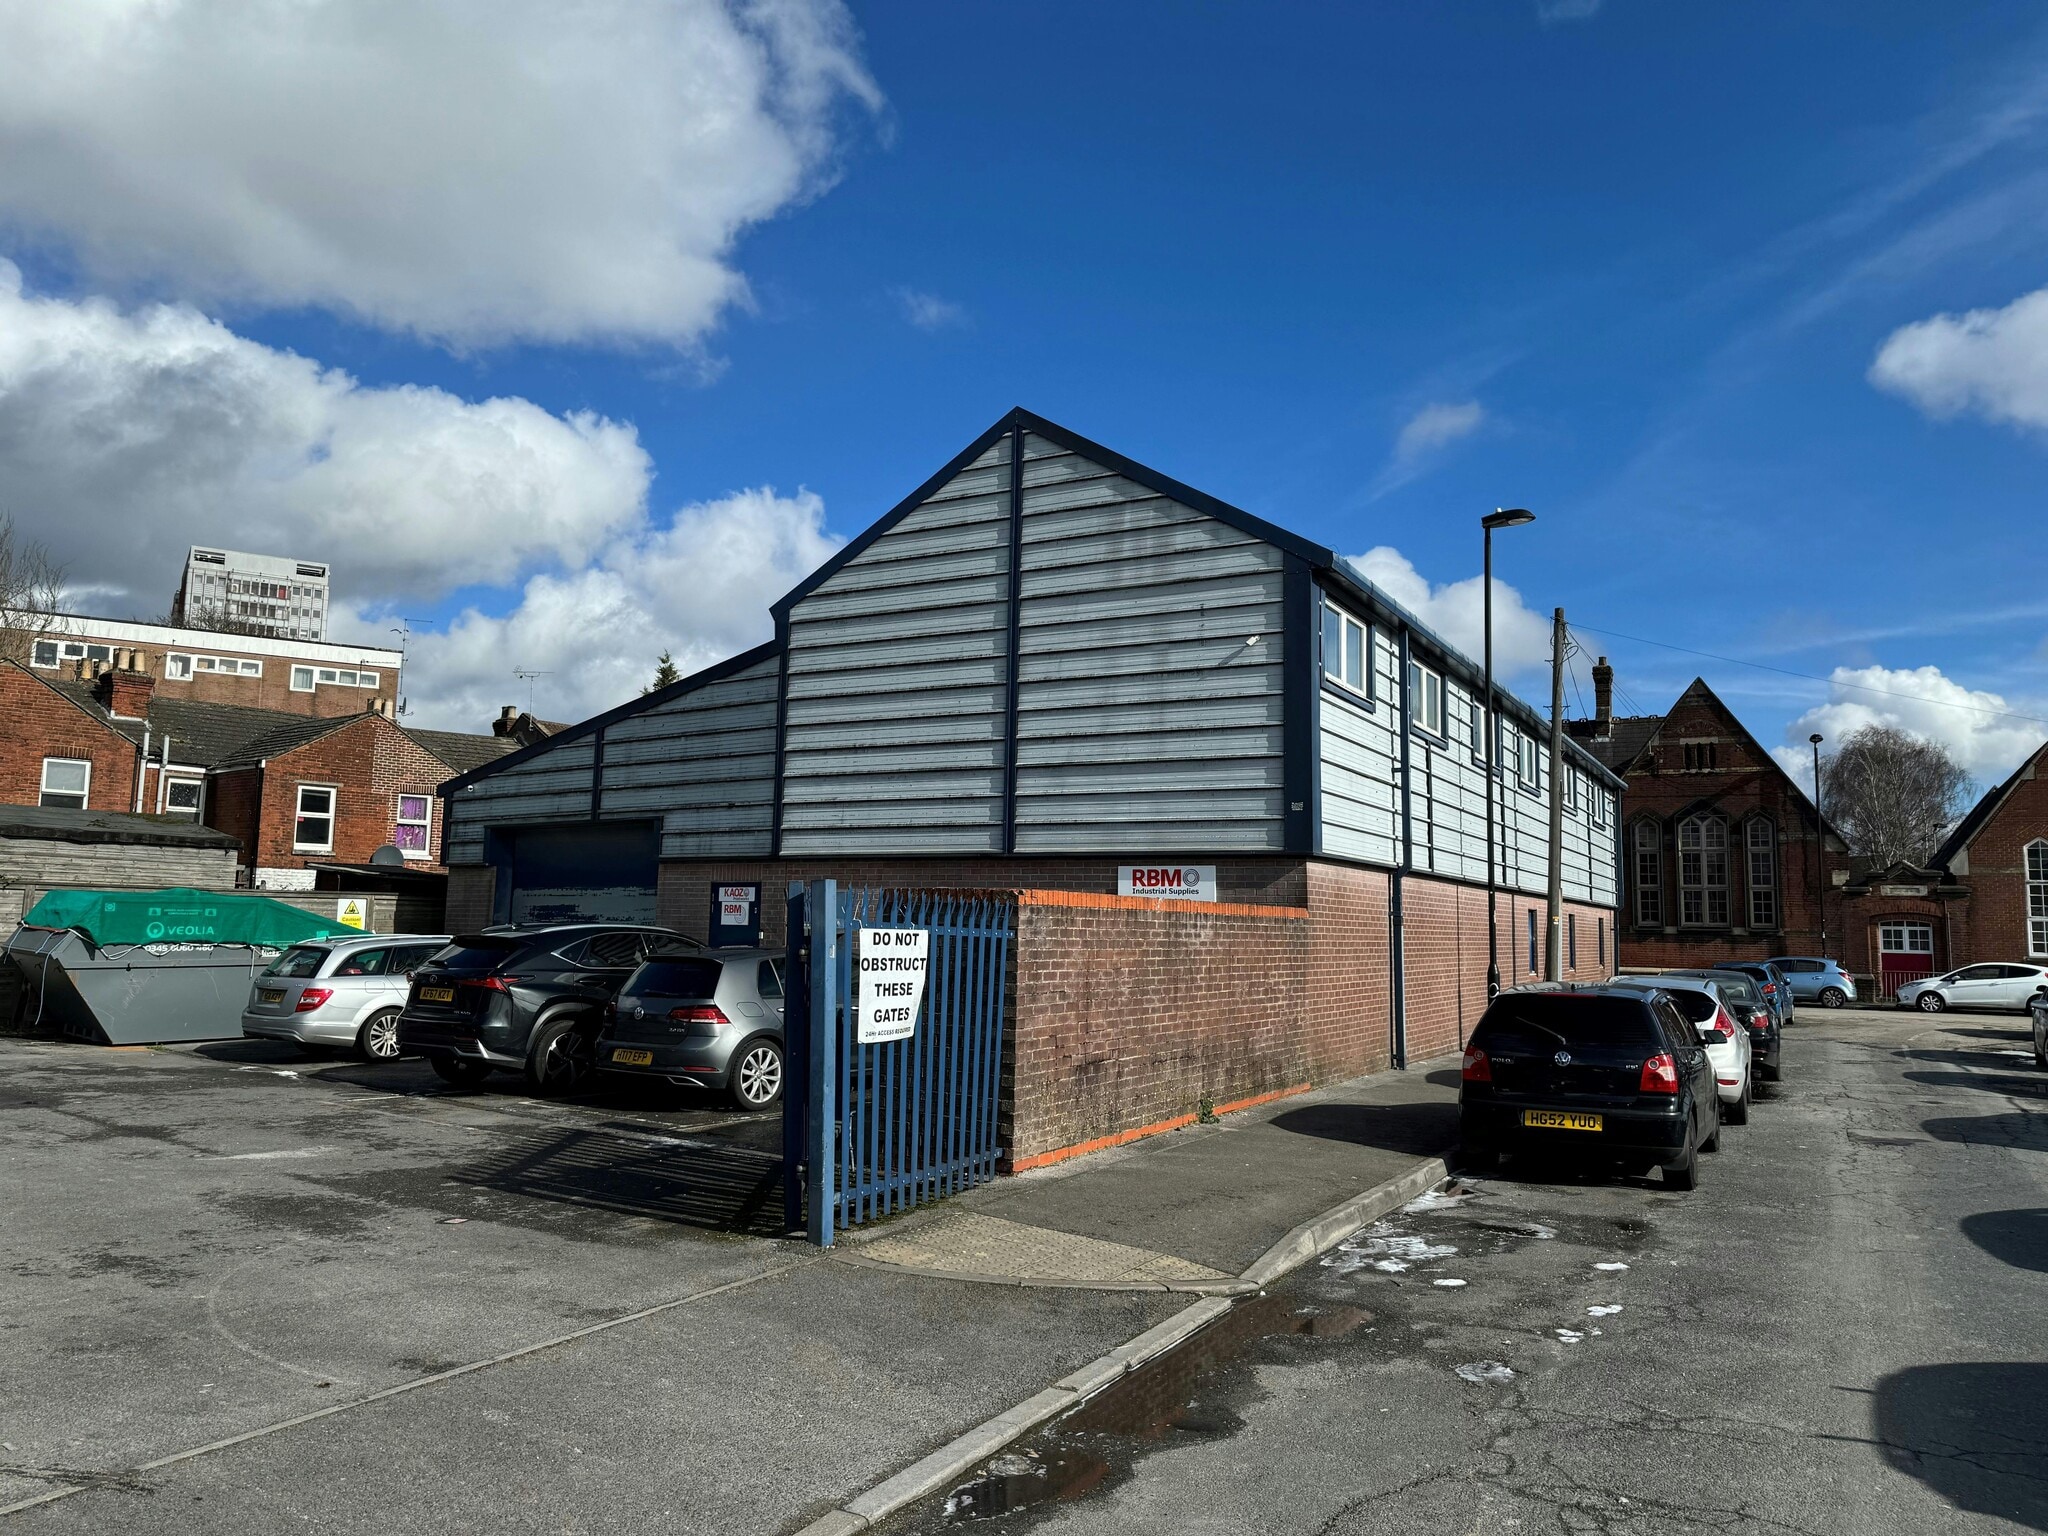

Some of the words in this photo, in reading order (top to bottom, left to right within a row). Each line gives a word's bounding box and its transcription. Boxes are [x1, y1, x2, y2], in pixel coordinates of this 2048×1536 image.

[1132, 869, 1182, 887] RBM
[1168, 888, 1199, 896] Supplies
[724, 904, 742, 914] RBM
[167, 926, 215, 935] VEOLIA
[873, 932, 891, 946] DO
[895, 932, 920, 946] NOT
[861, 957, 927, 972] OBSTRUCT
[874, 982, 914, 997] THESE
[873, 1007, 910, 1023] GATES
[633, 1052, 648, 1063] EFP
[1531, 1112, 1566, 1127] HG52
[1570, 1114, 1596, 1128] YUO
